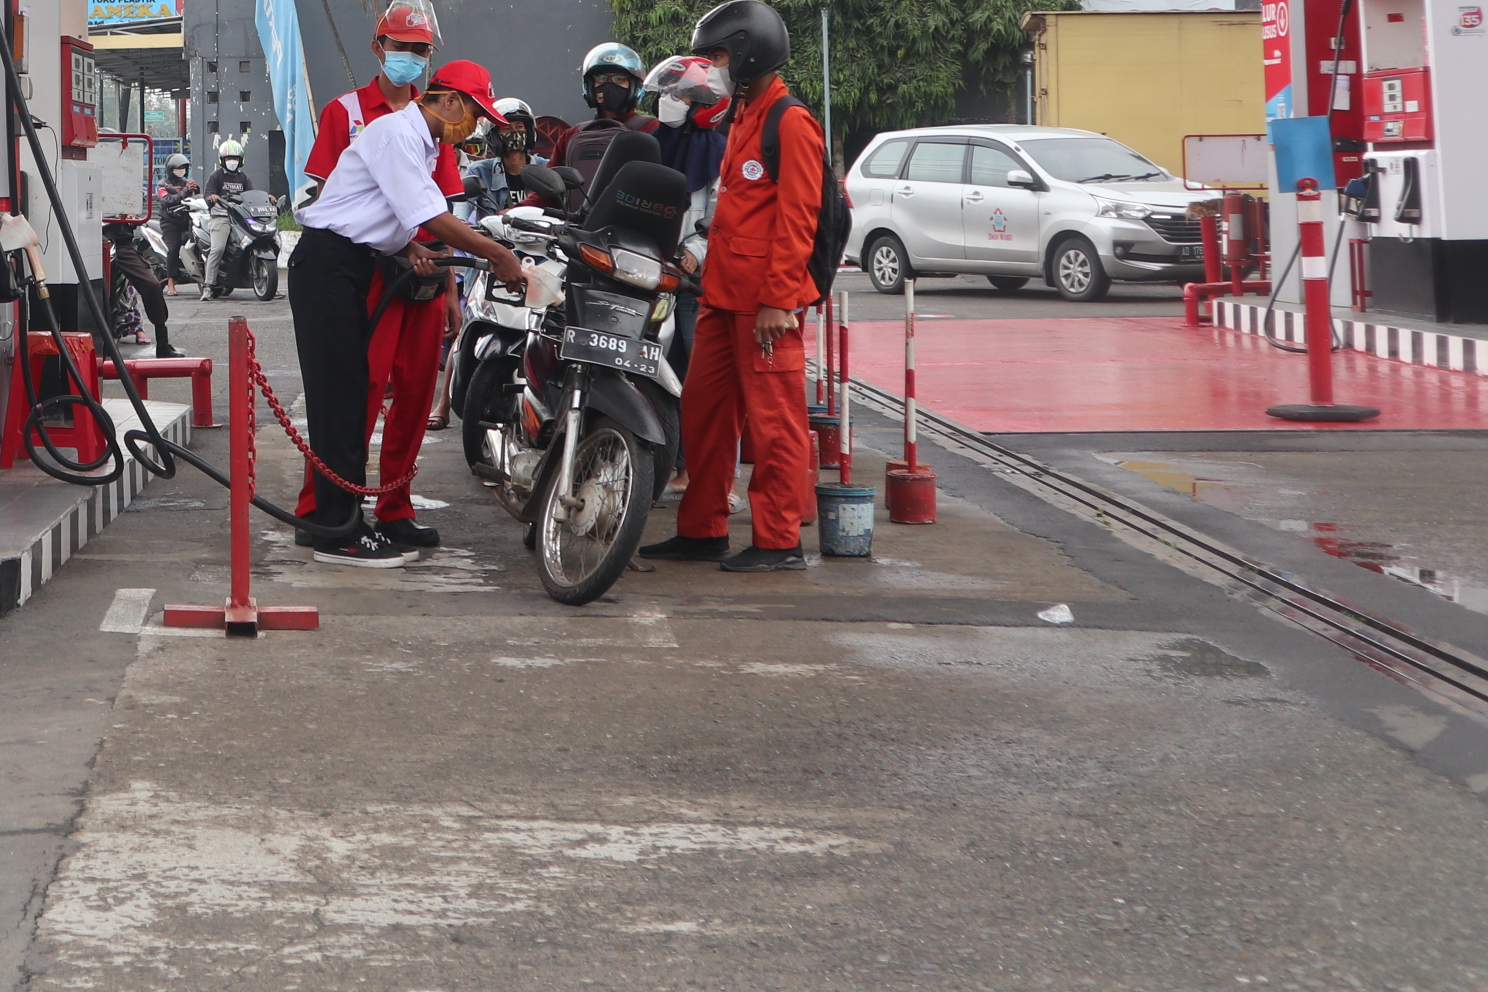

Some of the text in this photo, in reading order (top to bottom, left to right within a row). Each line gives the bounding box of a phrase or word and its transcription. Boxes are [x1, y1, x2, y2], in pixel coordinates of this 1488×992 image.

[89, 4, 173, 19] ANEKA
[566, 329, 660, 361] R 3689 AH
